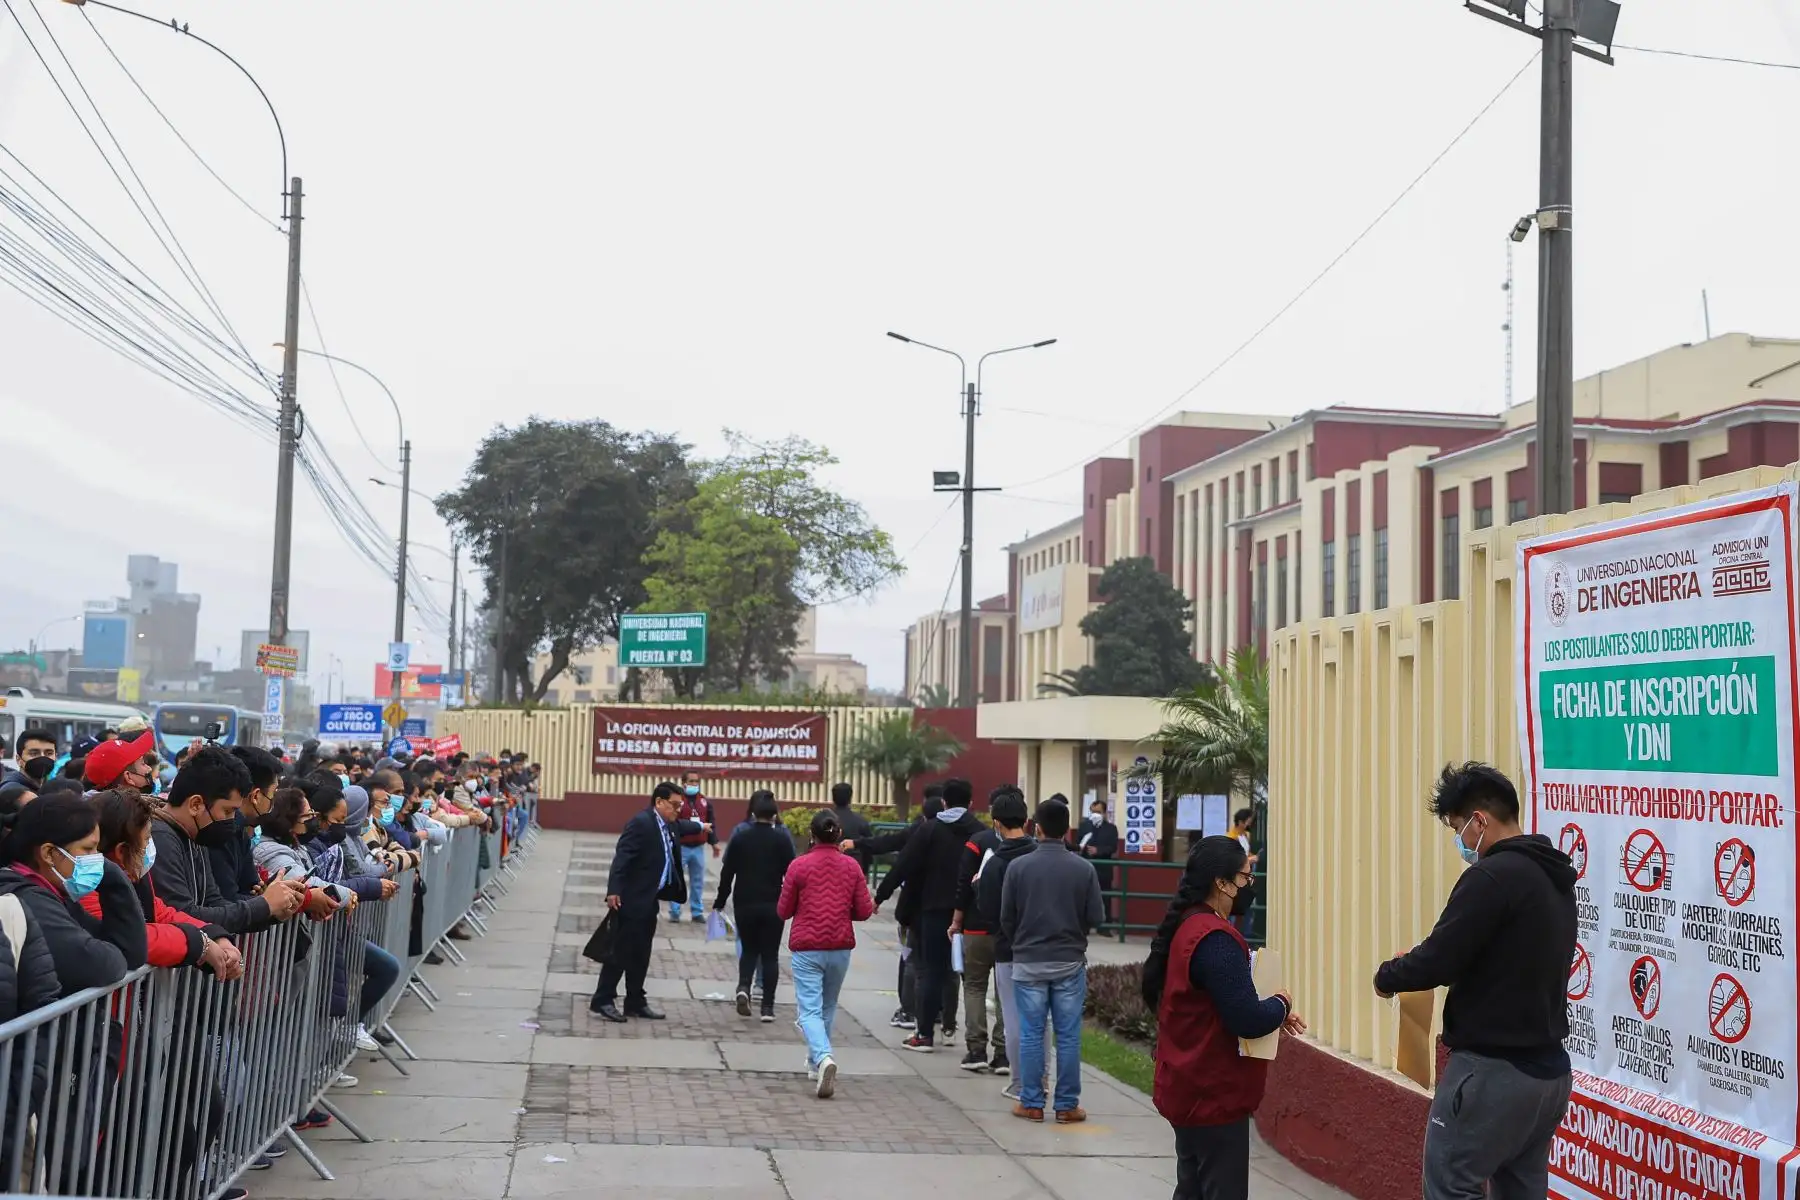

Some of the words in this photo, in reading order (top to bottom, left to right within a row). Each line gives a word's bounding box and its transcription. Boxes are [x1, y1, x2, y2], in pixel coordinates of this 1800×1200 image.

[1754, 535, 1769, 549] UNI
[1577, 559, 1639, 583] UNIVERSIDAD
[1639, 549, 1698, 573] NACIONAL
[1718, 554, 1739, 565] OFICINA
[1741, 551, 1763, 562] CENTRAL
[1578, 586, 1598, 613] DE
[1602, 571, 1702, 610] INGENIERÍA
[624, 617, 668, 629] UNIVERSIDAD
[669, 616, 703, 628] NACIONAL
[637, 630, 647, 642] DE
[1544, 640, 1561, 662] LOS
[1562, 632, 1629, 660] POSTULANTES
[1631, 629, 1659, 655] SOLO
[1662, 627, 1699, 652] DEBEN
[1701, 621, 1755, 649] PORTAR:
[629, 650, 665, 663] PUERTA
[680, 649, 693, 662] 03
[1553, 681, 1601, 719] FICHA
[1604, 679, 1628, 717] DE
[1630, 661, 1758, 717] INSCRIPCIÓN
[326, 721, 377, 731] OLIVEROS
[606, 722, 620, 734] LA
[622, 723, 671, 736] OFICINA
[673, 724, 724, 738] CENTRAL
[727, 726, 742, 738] DE
[744, 724, 811, 739] ADMISIÓN
[598, 738, 614, 752] TE
[616, 739, 660, 754] DESEA
[663, 737, 706, 756] ÉXITO
[708, 743, 728, 757] EN
[730, 743, 749, 757] TU
[752, 744, 817, 759] EXAMEN
[1623, 723, 1635, 761] Y
[1638, 722, 1672, 761] DNI
[1542, 783, 1619, 815] TOTALMENTE
[1621, 786, 1706, 822] PROHIBIDO
[1709, 790, 1784, 828] PORTAR:
[1614, 892, 1660, 914] CUALQUIER
[1661, 898, 1676, 917] TIPO
[1625, 911, 1638, 929] DE
[1728, 910, 1783, 938] MORRALES,
[1708, 945, 1740, 971] GORROS,
[1742, 952, 1761, 973] ETC
[1728, 930, 1785, 960] MALETINES,
[1687, 1034, 1731, 1064] ALIMENTOS
[1732, 1047, 1739, 1067] Y
[1741, 1050, 1785, 1080] BEBIDAS
[1653, 1064, 1669, 1084] ETC
[1695, 1111, 1768, 1151] VESTIMENTA
[1560, 1100, 1645, 1163] COMISADO
[1647, 1132, 1674, 1174] NO
[1675, 1154, 1746, 1200] TENDRÁ
[1548, 1135, 1600, 1188] OPCIÓN
[1602, 1159, 1613, 1195] A
